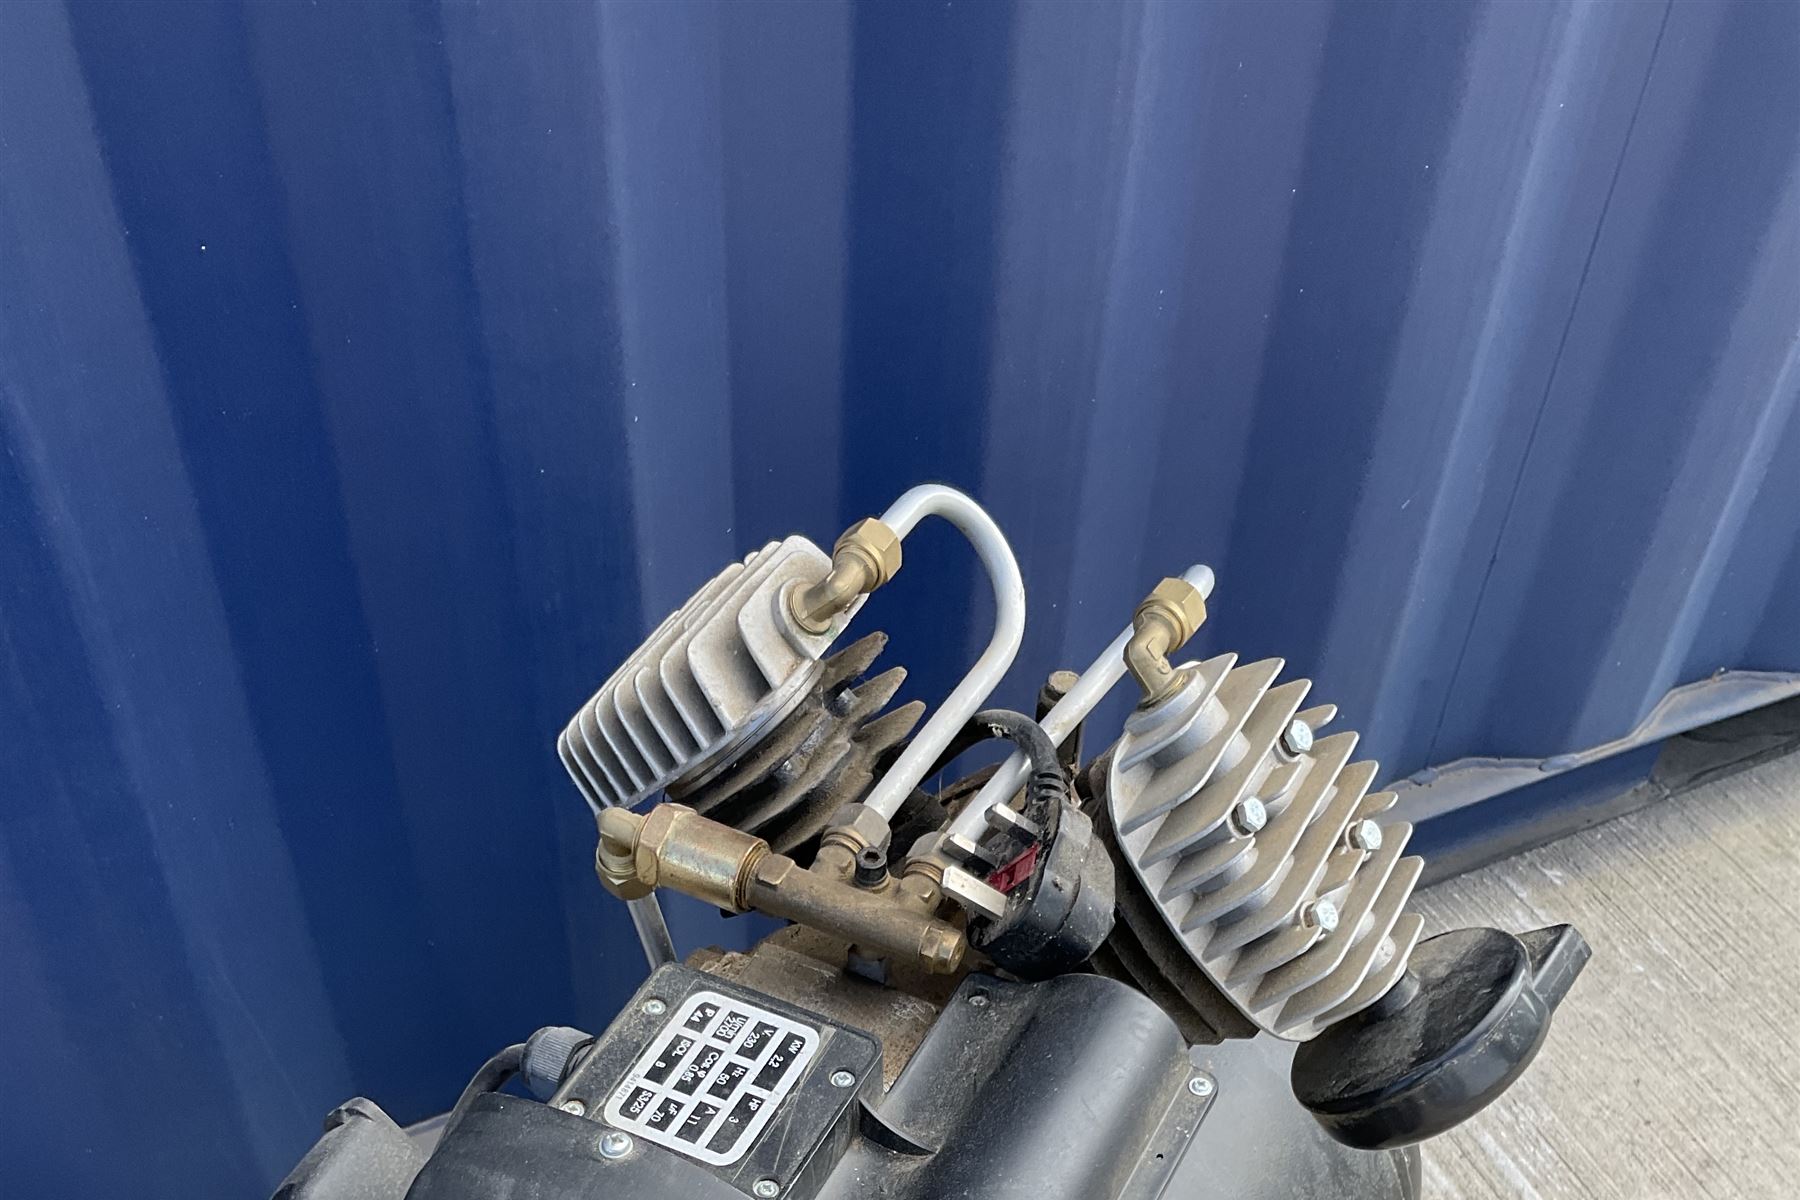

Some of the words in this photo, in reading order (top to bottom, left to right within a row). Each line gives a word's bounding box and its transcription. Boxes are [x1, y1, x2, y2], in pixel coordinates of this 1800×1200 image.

[717, 1015, 735, 1037] 2700
[743, 1033, 760, 1048] 230
[732, 1068, 746, 1077] Hz
[717, 1073, 730, 1085] 50
[629, 1090, 653, 1113] S3/25
[748, 1098, 762, 1111] HP
[650, 1109, 665, 1122] 70
[704, 1107, 716, 1115] A
[686, 1115, 701, 1125] 11
[728, 1116, 739, 1124] 3
